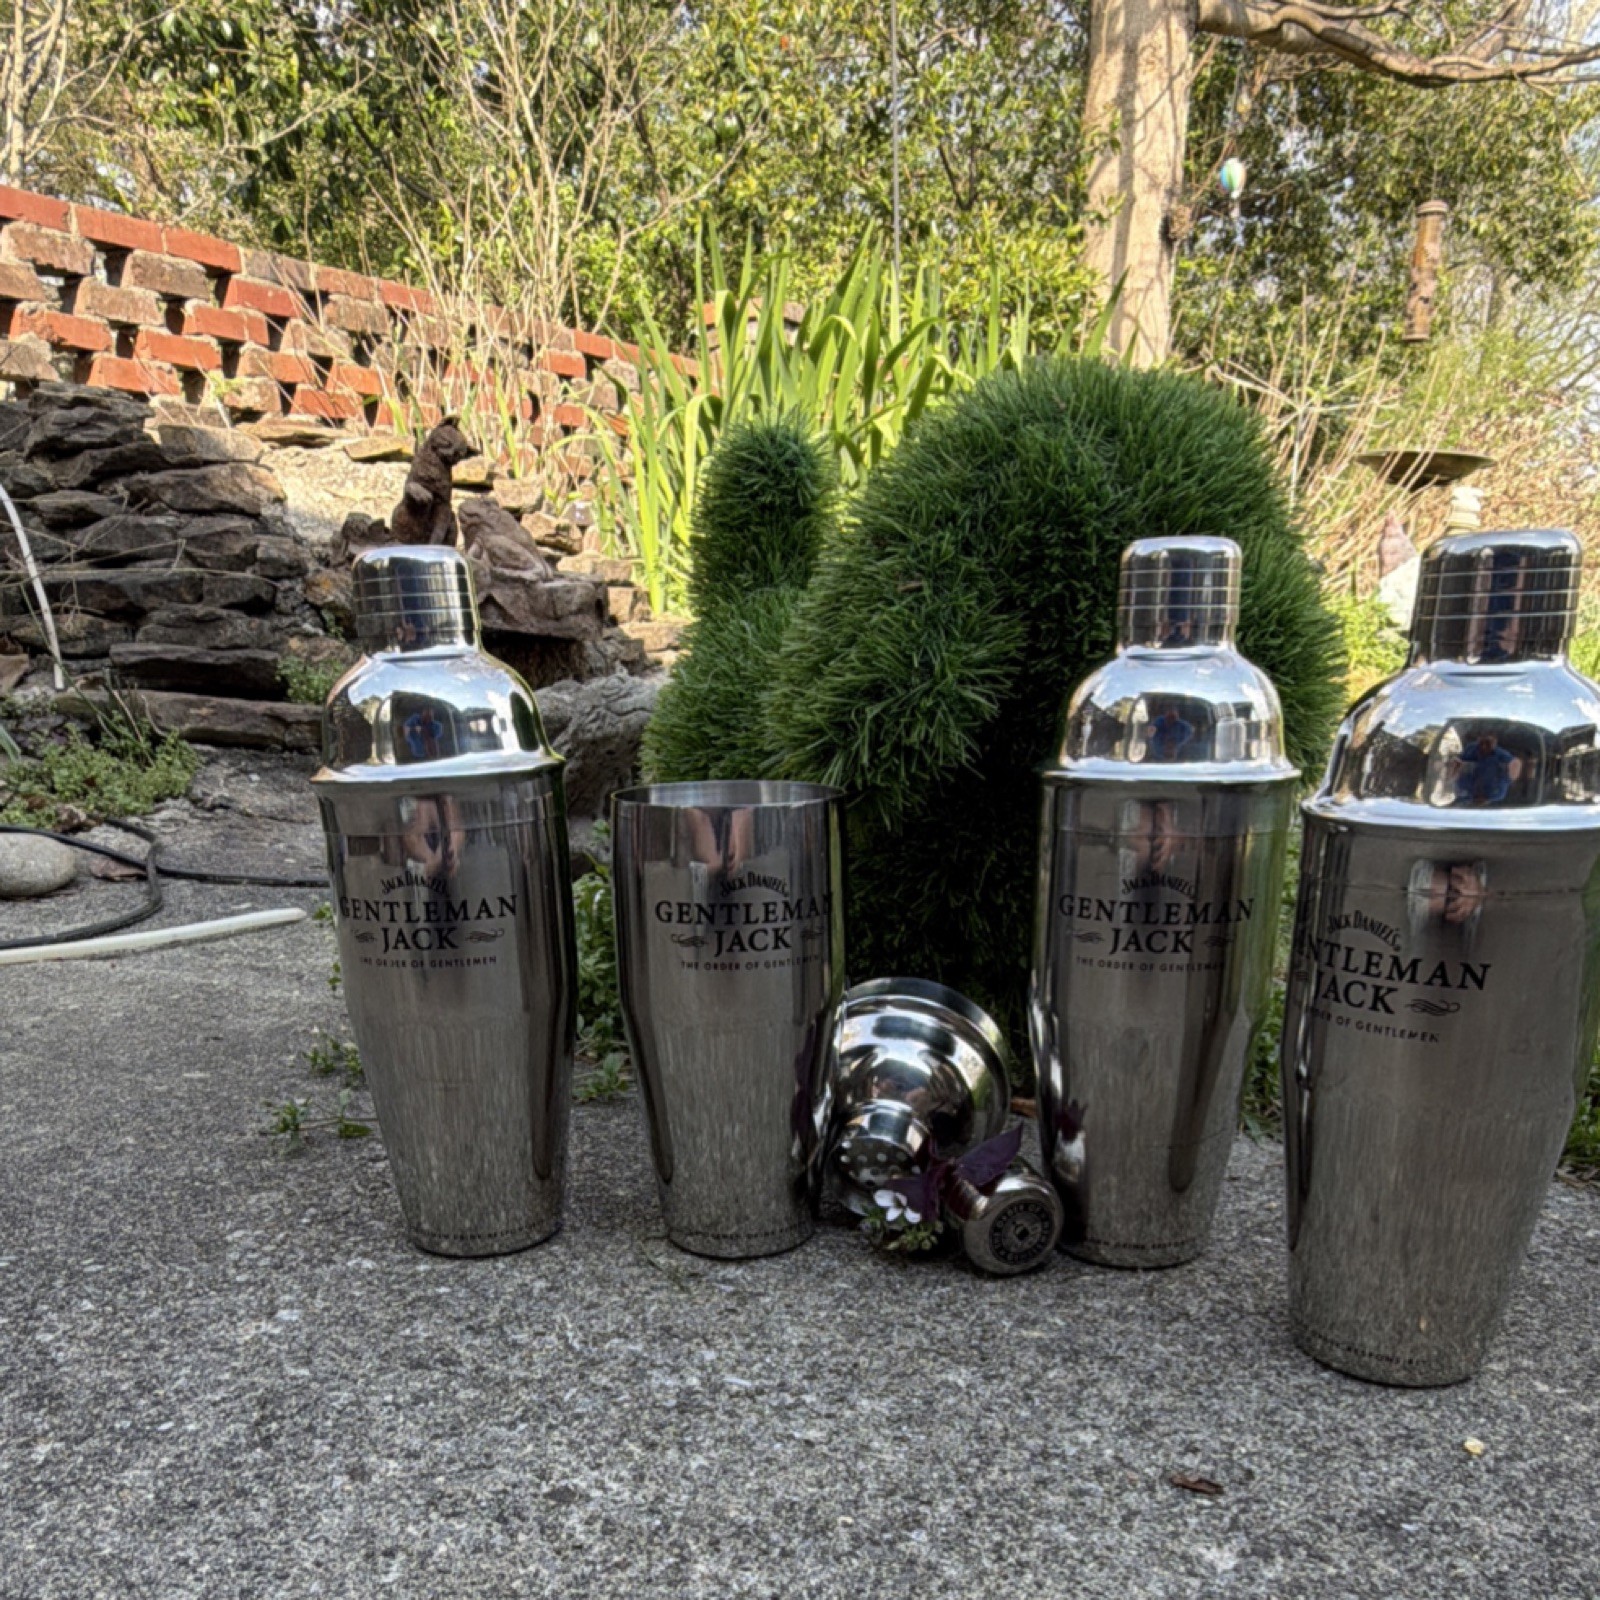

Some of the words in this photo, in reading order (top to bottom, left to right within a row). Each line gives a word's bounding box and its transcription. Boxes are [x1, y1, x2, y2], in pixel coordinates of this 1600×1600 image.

[339, 894, 518, 924] GENTLEMAN
[1058, 894, 1255, 925] GENTLEMAN
[380, 926, 460, 954] JACK
[713, 925, 793, 958] JACK
[1109, 927, 1194, 955] JACK
[430, 955, 497, 968] GENTLEMEN
[681, 960, 699, 971] THE
[703, 961, 741, 972] ORDER
[745, 960, 761, 970] OF
[1076, 955, 1094, 968] THE
[1097, 958, 1134, 970] ORDER
[1139, 961, 1155, 971] OF
[1313, 970, 1399, 1015] JACK
[1336, 1014, 1352, 1028] OF
[1355, 1019, 1440, 1044] GENTLEMEN
